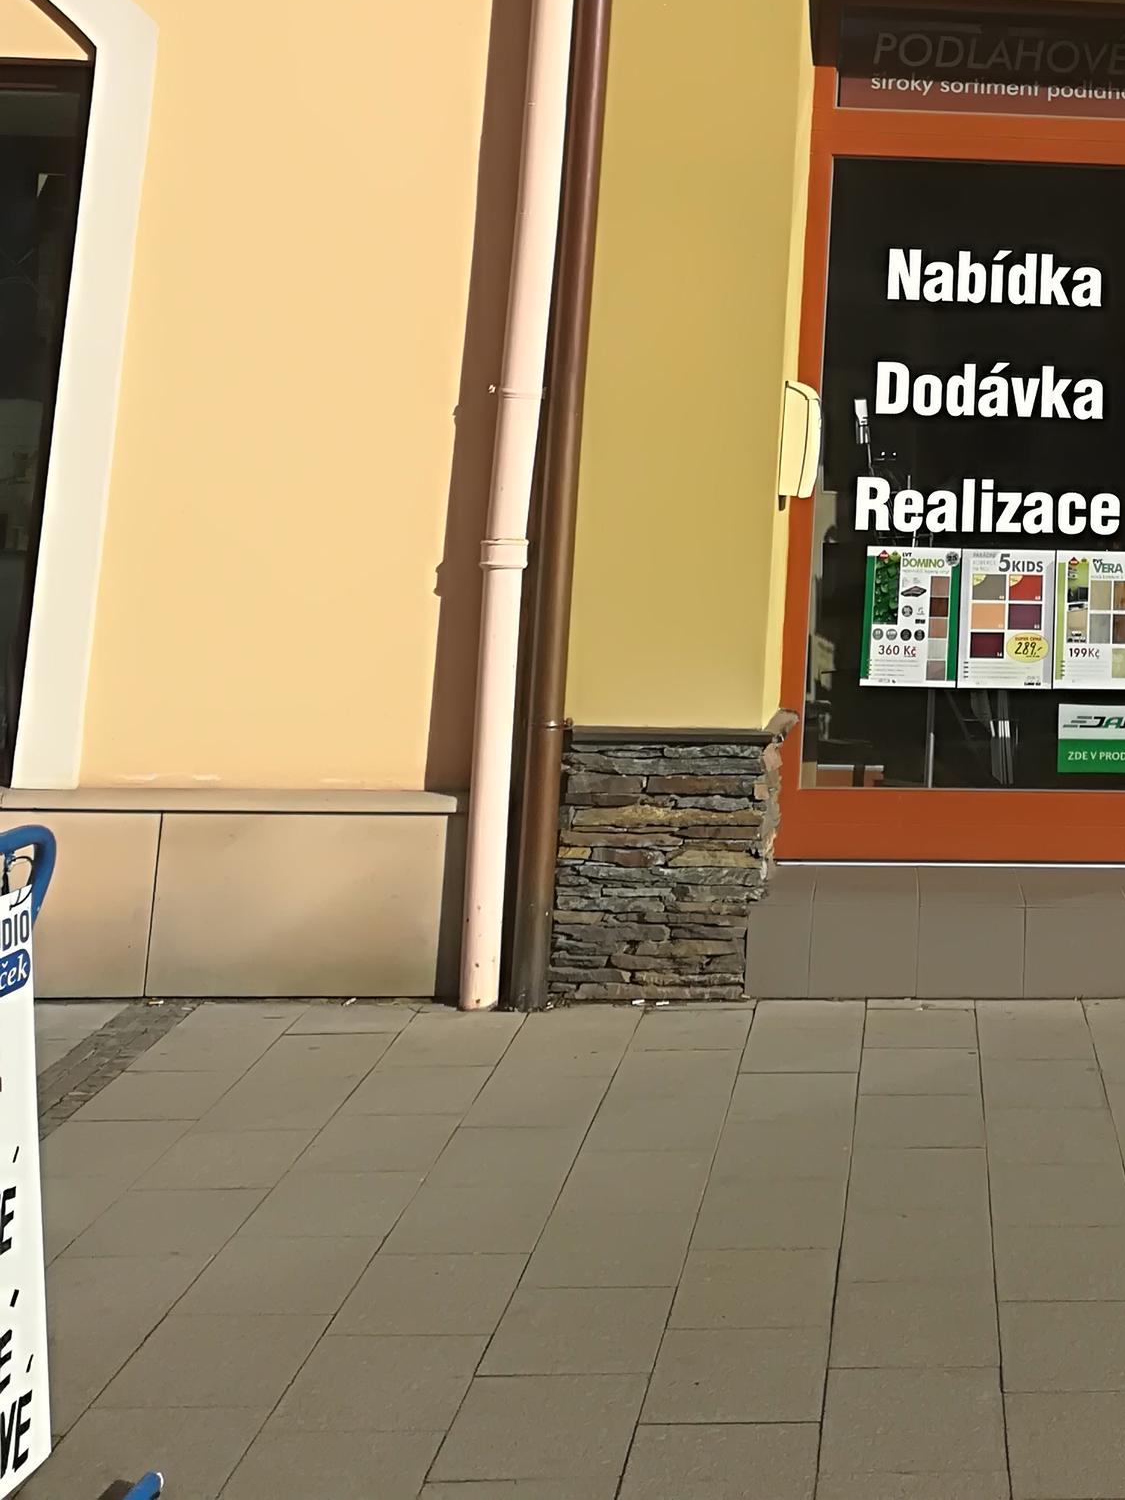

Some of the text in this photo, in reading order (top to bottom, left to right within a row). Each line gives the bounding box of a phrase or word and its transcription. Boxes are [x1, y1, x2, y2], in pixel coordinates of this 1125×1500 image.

[940, 77, 1040, 97] sortiment
[887, 248, 1102, 307] Nabídka
[875, 361, 1104, 420] Dodávka
[855, 476, 1121, 535] Realizace
[902, 558, 945, 568] DOMINO
[998, 553, 1044, 573] 5 KIDS
[1093, 563, 1124, 574] VERA
[878, 644, 917, 656] 360 Kč
[1069, 648, 1100, 659] 199 Kč
[1067, 750, 1089, 761] ZDE
[1090, 751, 1098, 761] V
